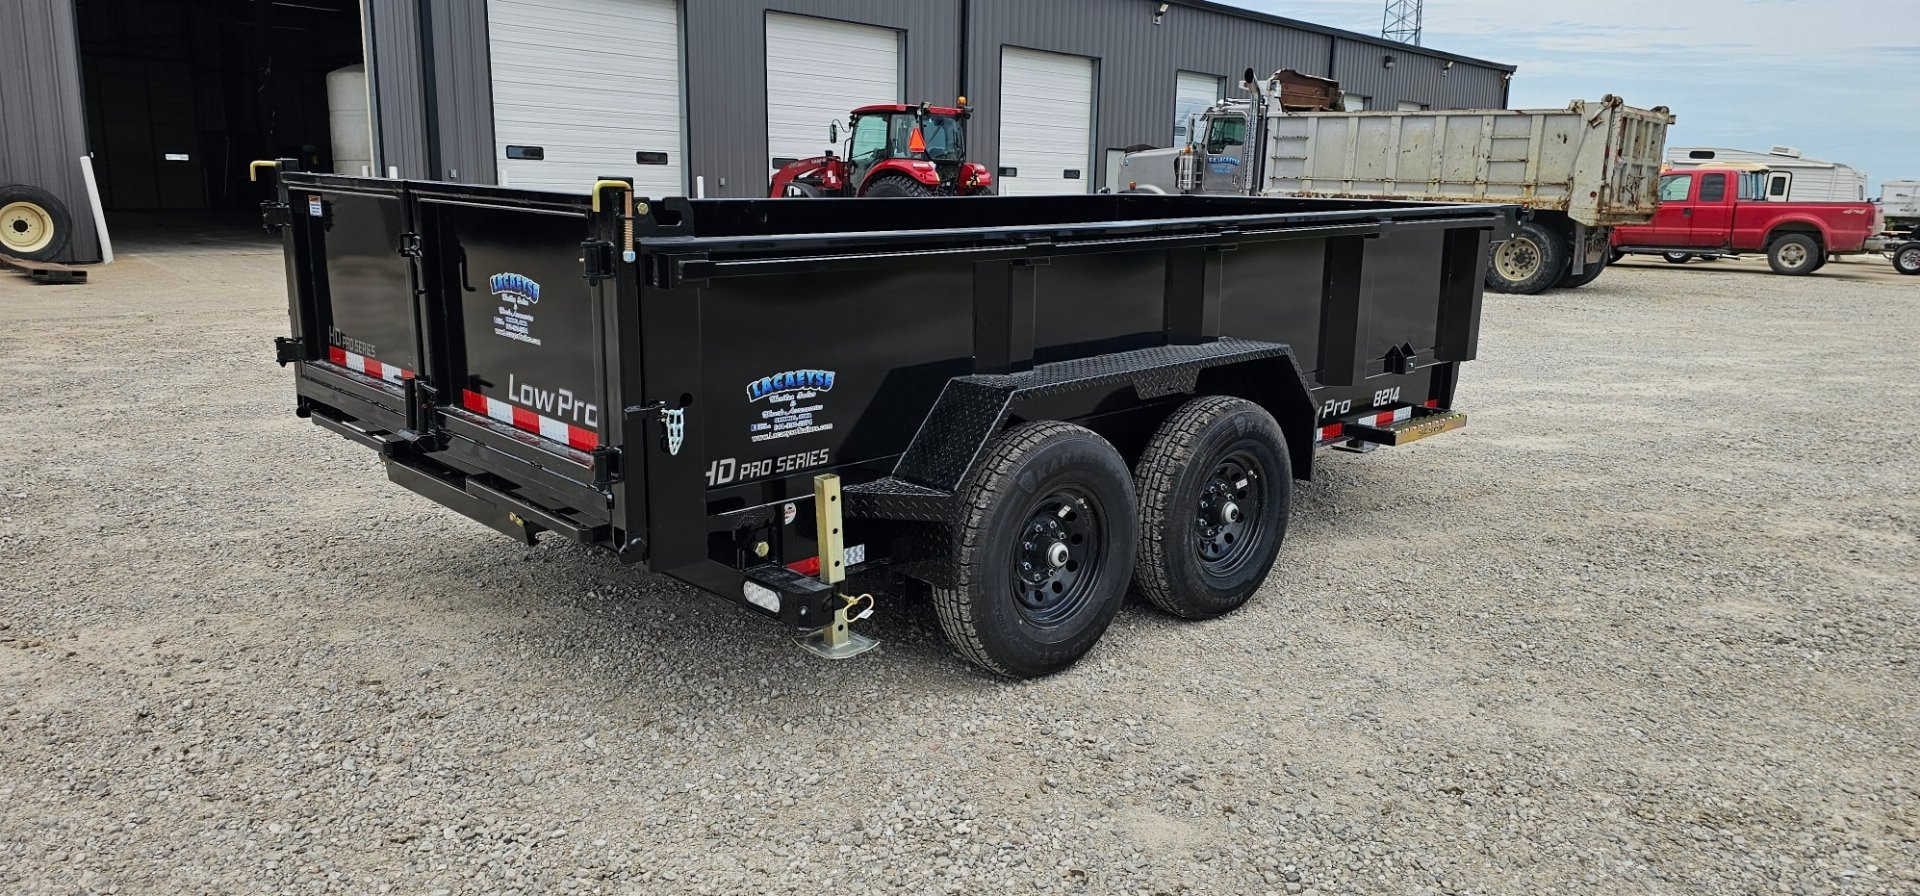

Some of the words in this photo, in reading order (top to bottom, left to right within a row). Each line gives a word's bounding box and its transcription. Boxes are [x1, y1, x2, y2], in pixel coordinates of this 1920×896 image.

[329, 325, 341, 346] HD
[342, 335, 354, 351] PRO
[354, 339, 376, 358] SERIES
[747, 369, 835, 403] LACAEYSE
[1372, 386, 1401, 408] 8214
[739, 459, 773, 481] PRO
[775, 448, 830, 474] SERIES
